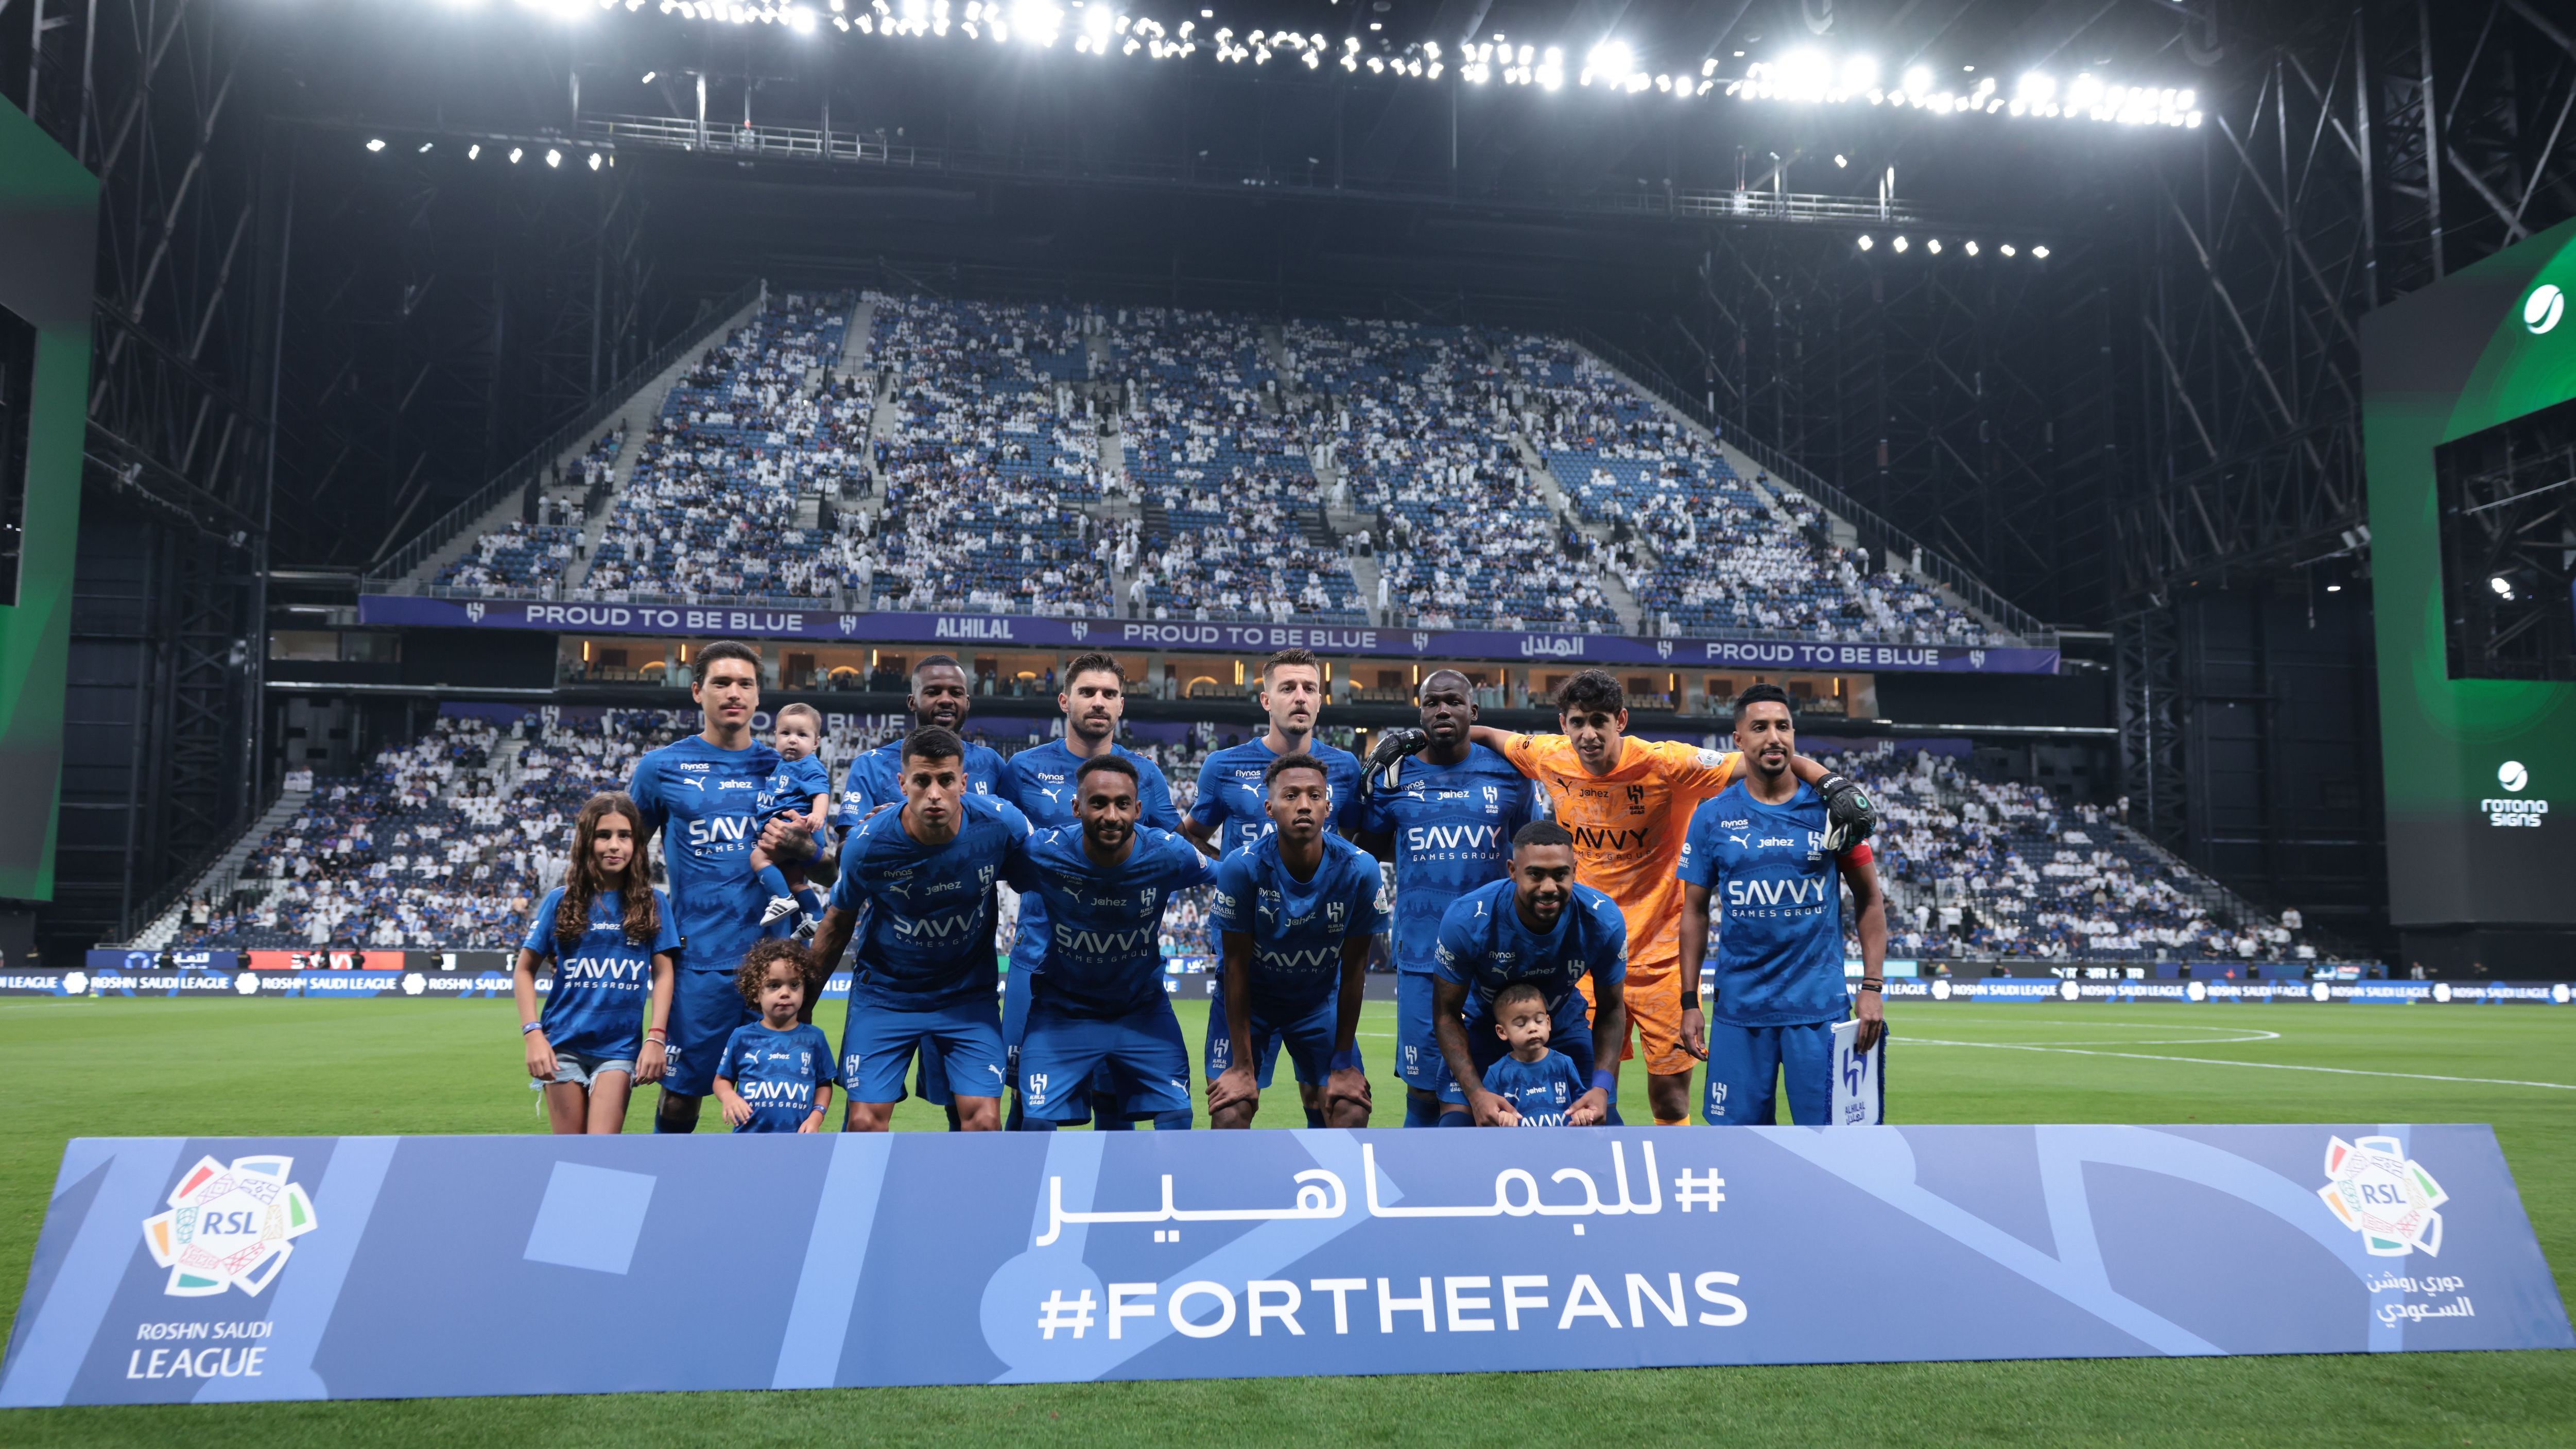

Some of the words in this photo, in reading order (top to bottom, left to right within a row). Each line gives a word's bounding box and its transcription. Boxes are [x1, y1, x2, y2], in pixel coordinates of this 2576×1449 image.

[526, 605, 630, 626] PROUD
[638, 609, 679, 628] TO
[686, 611, 722, 629] BE
[730, 613, 803, 631] BLUE
[936, 618, 1013, 639] ALHILAL
[1124, 624, 1219, 643] PROUD
[1227, 627, 1264, 645] TO
[1270, 628, 1303, 646] BE
[1310, 630, 1376, 648] BLUE
[1522, 635, 1584, 657] الهلال
[1706, 642, 1794, 662] PROUD
[1800, 646, 1835, 663] TO
[1840, 647, 1871, 664] BE
[1877, 647, 1939, 665] BLUE
[1038, 772, 1064, 782] flynas
[1236, 770, 1261, 778] flynas
[1721, 819, 1748, 828] flynas
[1408, 825, 1501, 850] SAVVY
[695, 843, 745, 856] GAMES
[1574, 850, 1601, 859] AMES
[1413, 853, 1455, 861] GAMES
[1258, 887, 1281, 898] flynas
[1728, 876, 1825, 905] SAVVY
[1211, 903, 1236, 915] ANABIL
[1056, 920, 1155, 954] SAVVY
[1111, 949, 1148, 962] GROU
[1253, 938, 1344, 967] SAVVY
[1489, 951, 1515, 960] flynas
[563, 957, 644, 981] SAVVY
[1255, 961, 1292, 973] AMES
[8, 976, 58, 988] LEAGUE
[90, 976, 139, 989] ROSHN
[139, 976, 179, 989] SAUDI
[181, 976, 229, 989] LEAGUE
[262, 977, 307, 990] ROSHN
[309, 977, 348, 990] SAUDI
[350, 977, 396, 990] LEAGUE
[428, 978, 473, 990] ROSHN
[475, 978, 513, 990] SAUDI
[602, 981, 640, 991] GROUP
[1890, 984, 1928, 995] LEAGUE
[1951, 984, 1988, 996] ROSHN
[1990, 984, 2019, 996] SAUDI
[2021, 984, 2058, 996] LEAGUE
[2081, 985, 2116, 997] ROSHN
[2118, 985, 2147, 997] SAUDI
[2149, 985, 2184, 997] LEAGUE
[2207, 986, 2242, 997] ROSHN
[2242, 986, 2271, 997] SAUDI
[2272, 986, 2309, 997] LEAGUE
[744, 1081, 809, 1101] SAVVY
[779, 1101, 807, 1109] GROUP
[1845, 1101, 1865, 1115] ALHILAL
[1521, 1113, 1566, 1127] AVVY
[1035, 1140, 1726, 1246] #للجماهير
[2361, 1184, 2406, 1203] RSL
[202, 1211, 257, 1235] RSL
[2366, 1270, 2418, 1293] روشن
[2419, 1275, 2465, 1297] دوري
[1037, 1271, 1749, 1340] #FORTHEFANS
[2376, 1296, 2476, 1328] السعودي
[136, 1321, 210, 1340] ROSHN
[212, 1321, 274, 1339] SAUDI
[126, 1347, 267, 1379] LEAGUE
